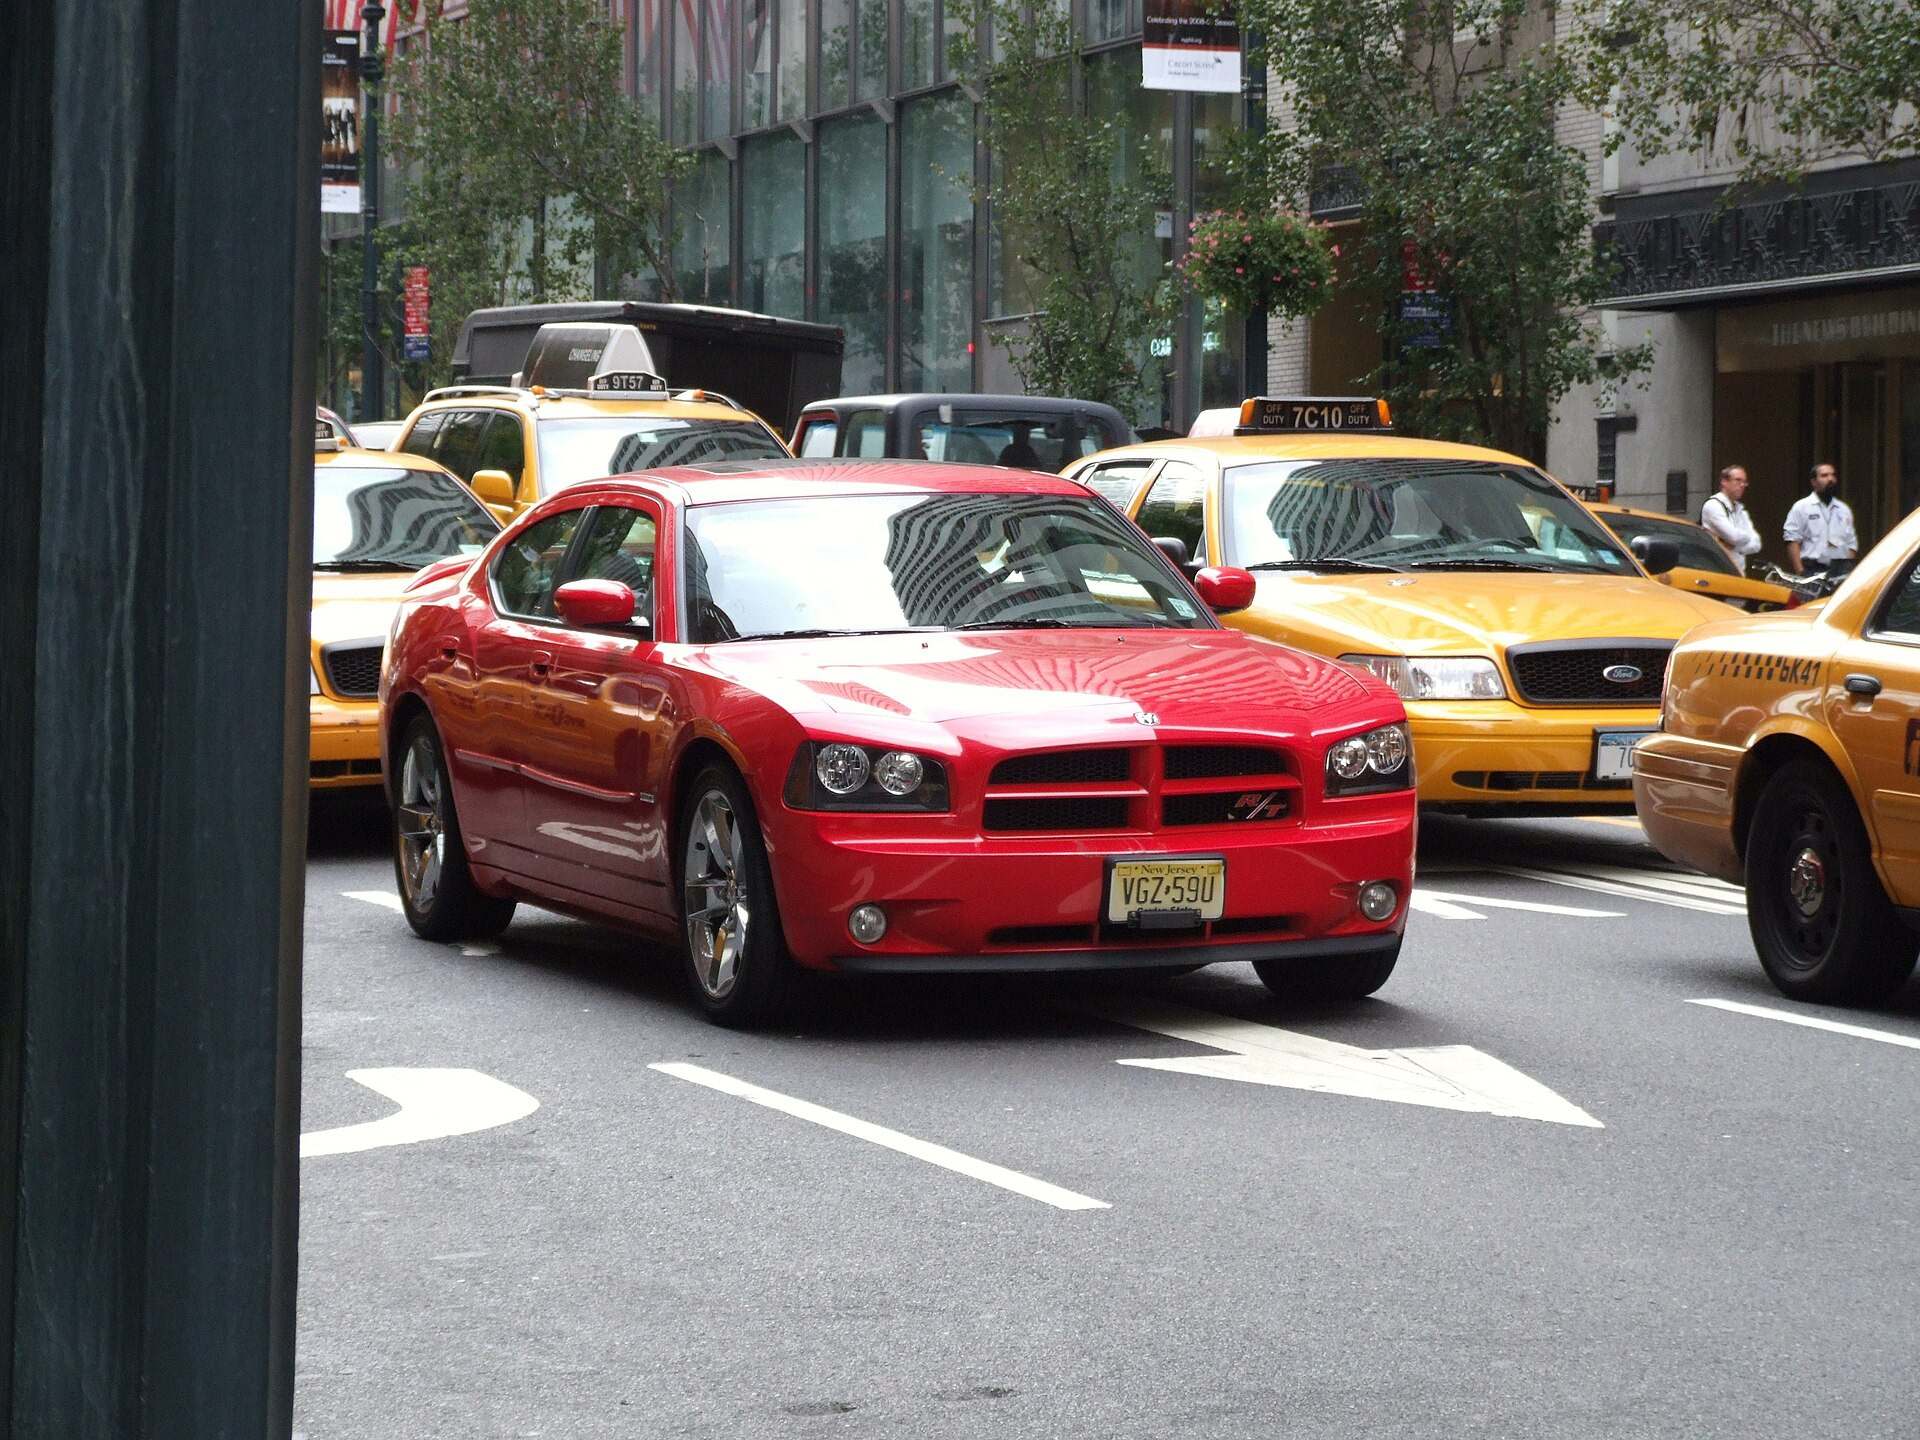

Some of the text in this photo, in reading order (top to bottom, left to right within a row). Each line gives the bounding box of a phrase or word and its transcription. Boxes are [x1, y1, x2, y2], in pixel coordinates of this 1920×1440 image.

[612, 375, 644, 390] 9T57
[1263, 415, 1370, 425] DUTY DUTY
[1265, 404, 1366, 429] OFF 7C10 OFF
[1141, 865, 1198, 876] New Jersey
